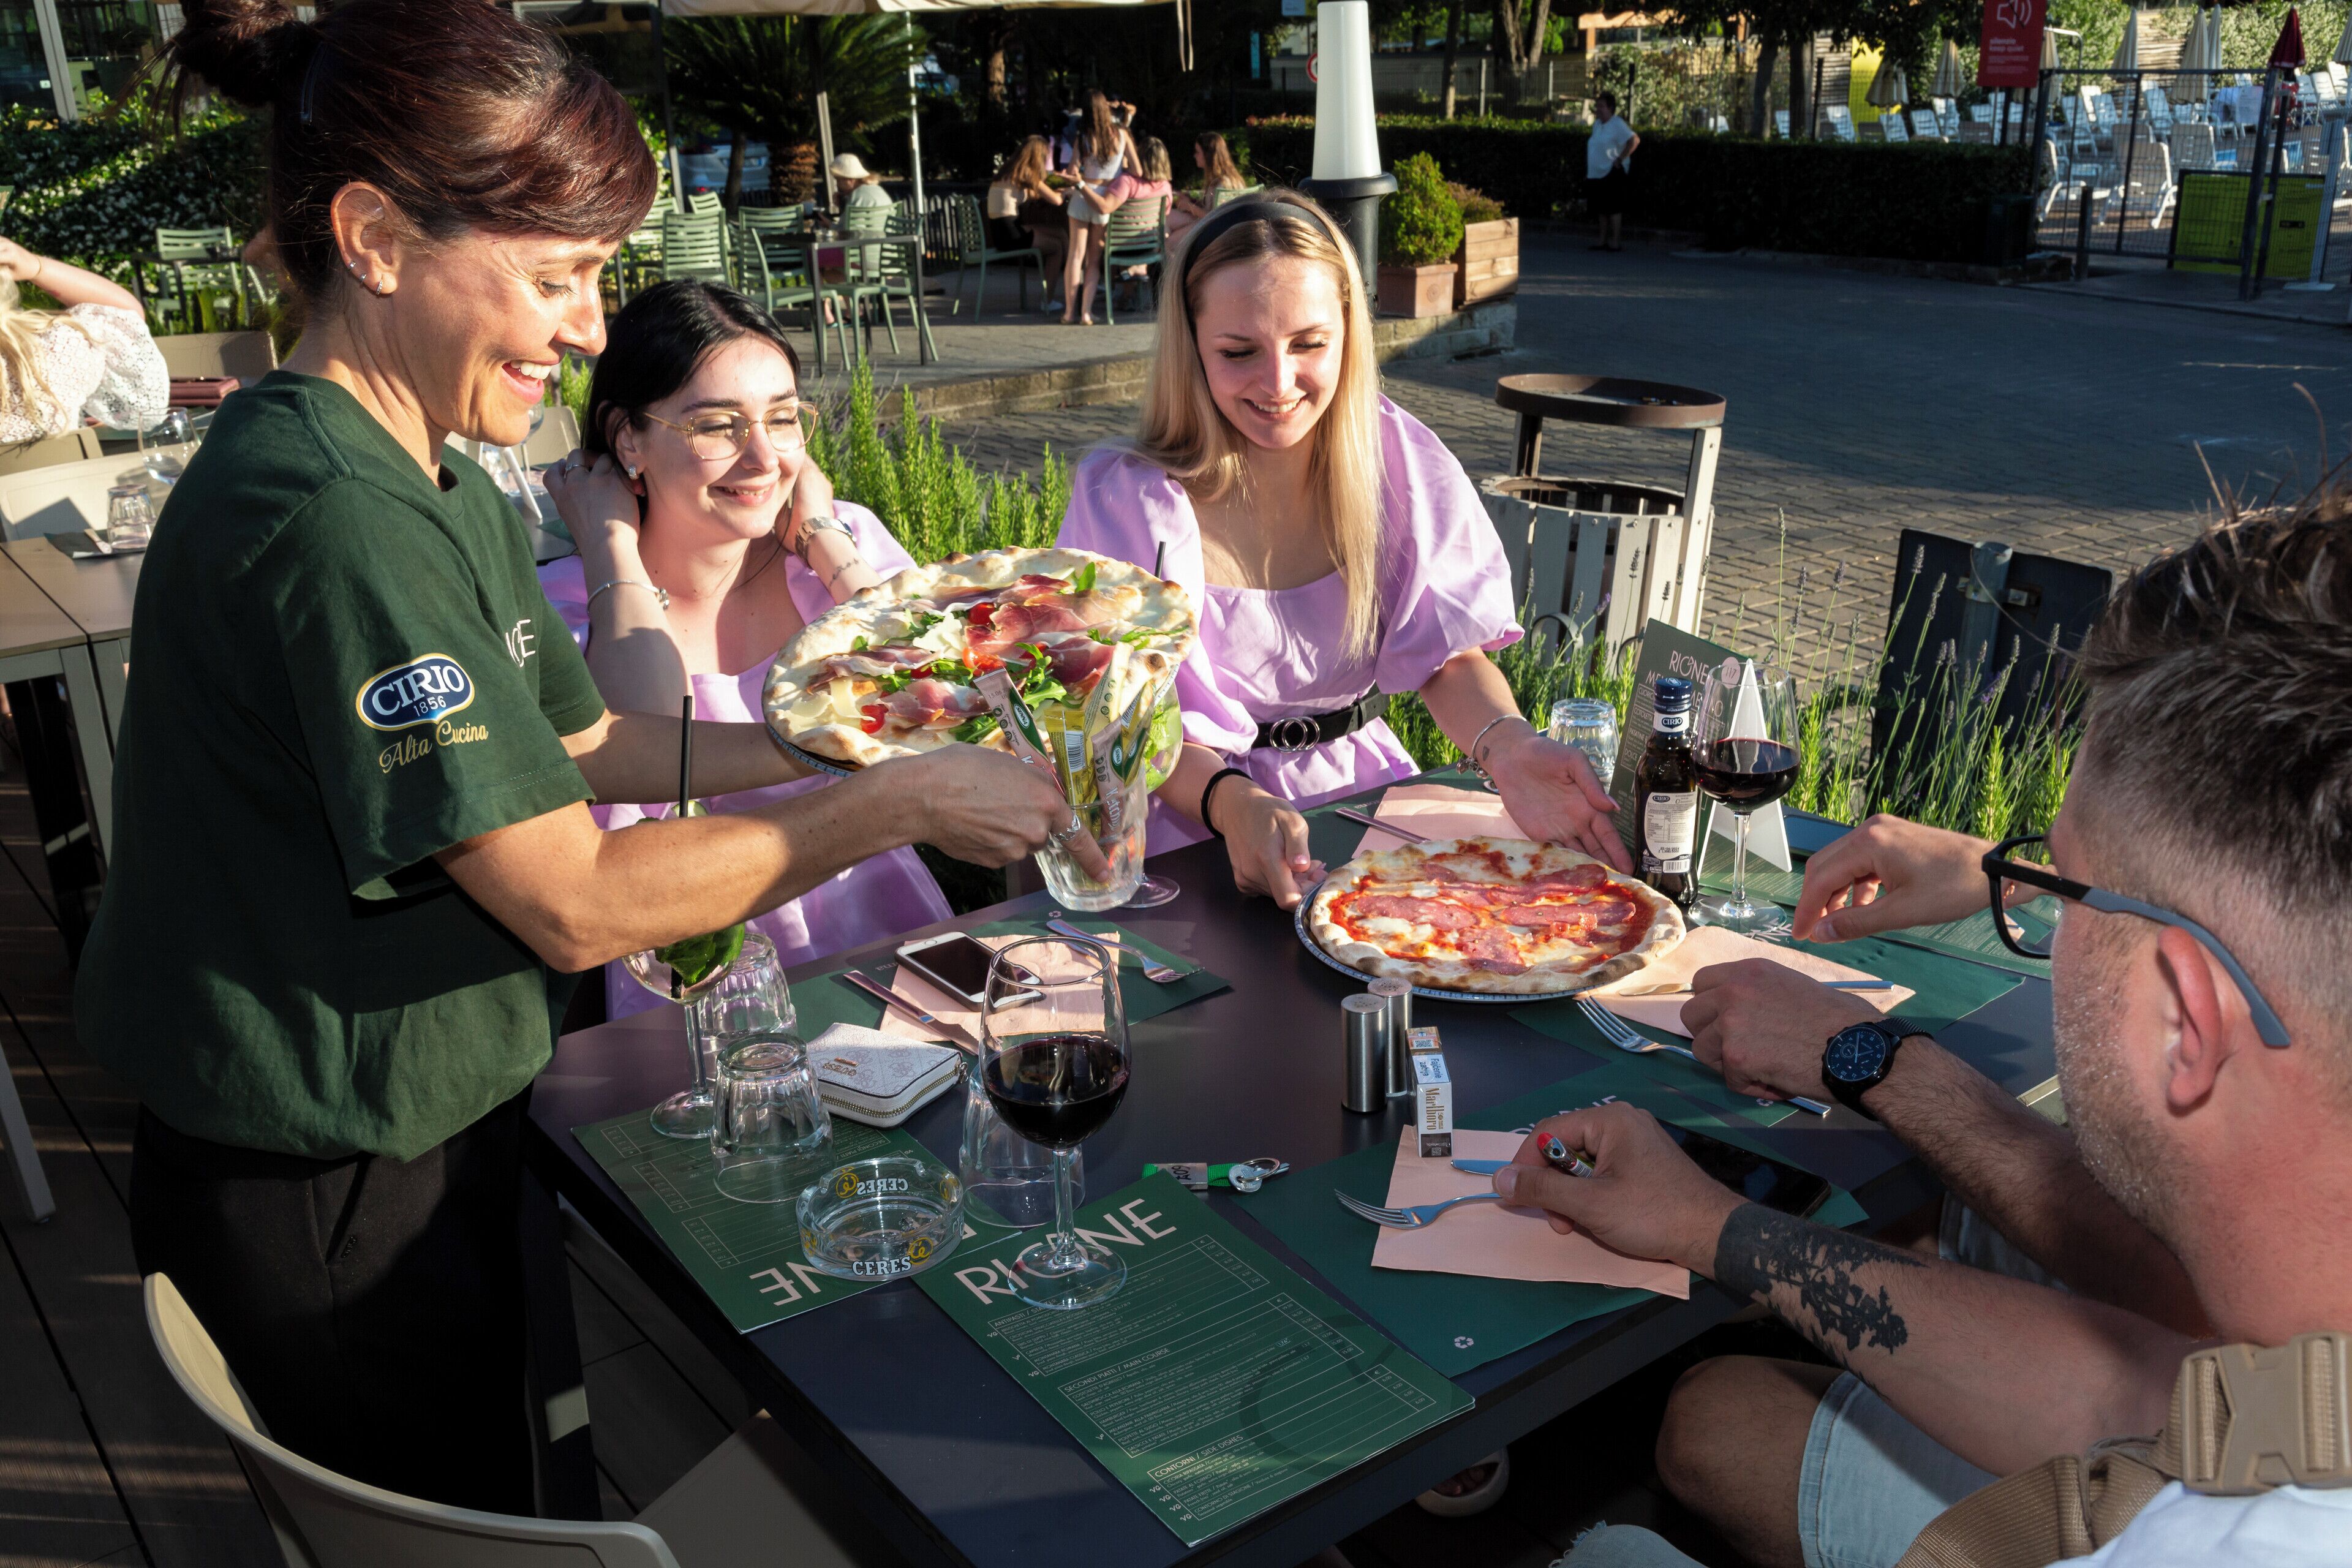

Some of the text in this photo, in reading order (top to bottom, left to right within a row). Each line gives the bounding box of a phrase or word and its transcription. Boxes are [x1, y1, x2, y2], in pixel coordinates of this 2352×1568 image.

[1668, 650, 1709, 685] RIONE
[372, 665, 465, 716] CIRIO
[413, 696, 447, 717] 1856
[1016, 707, 1028, 726] SENNA
[379, 720, 489, 774] Alta Cucina
[1106, 787, 1123, 831] Ktchup
[1425, 1088, 1444, 1130] Marlboro
[852, 1256, 912, 1276] CERES
[954, 1199, 1177, 1305] RIONE
[993, 1311, 1026, 1327] ANTIPASTI
[1063, 1346, 1171, 1393] SECONDI PIATTI MAIN COURSE
[1153, 1433, 1245, 1479] CONTORNI SIDE DISHES
